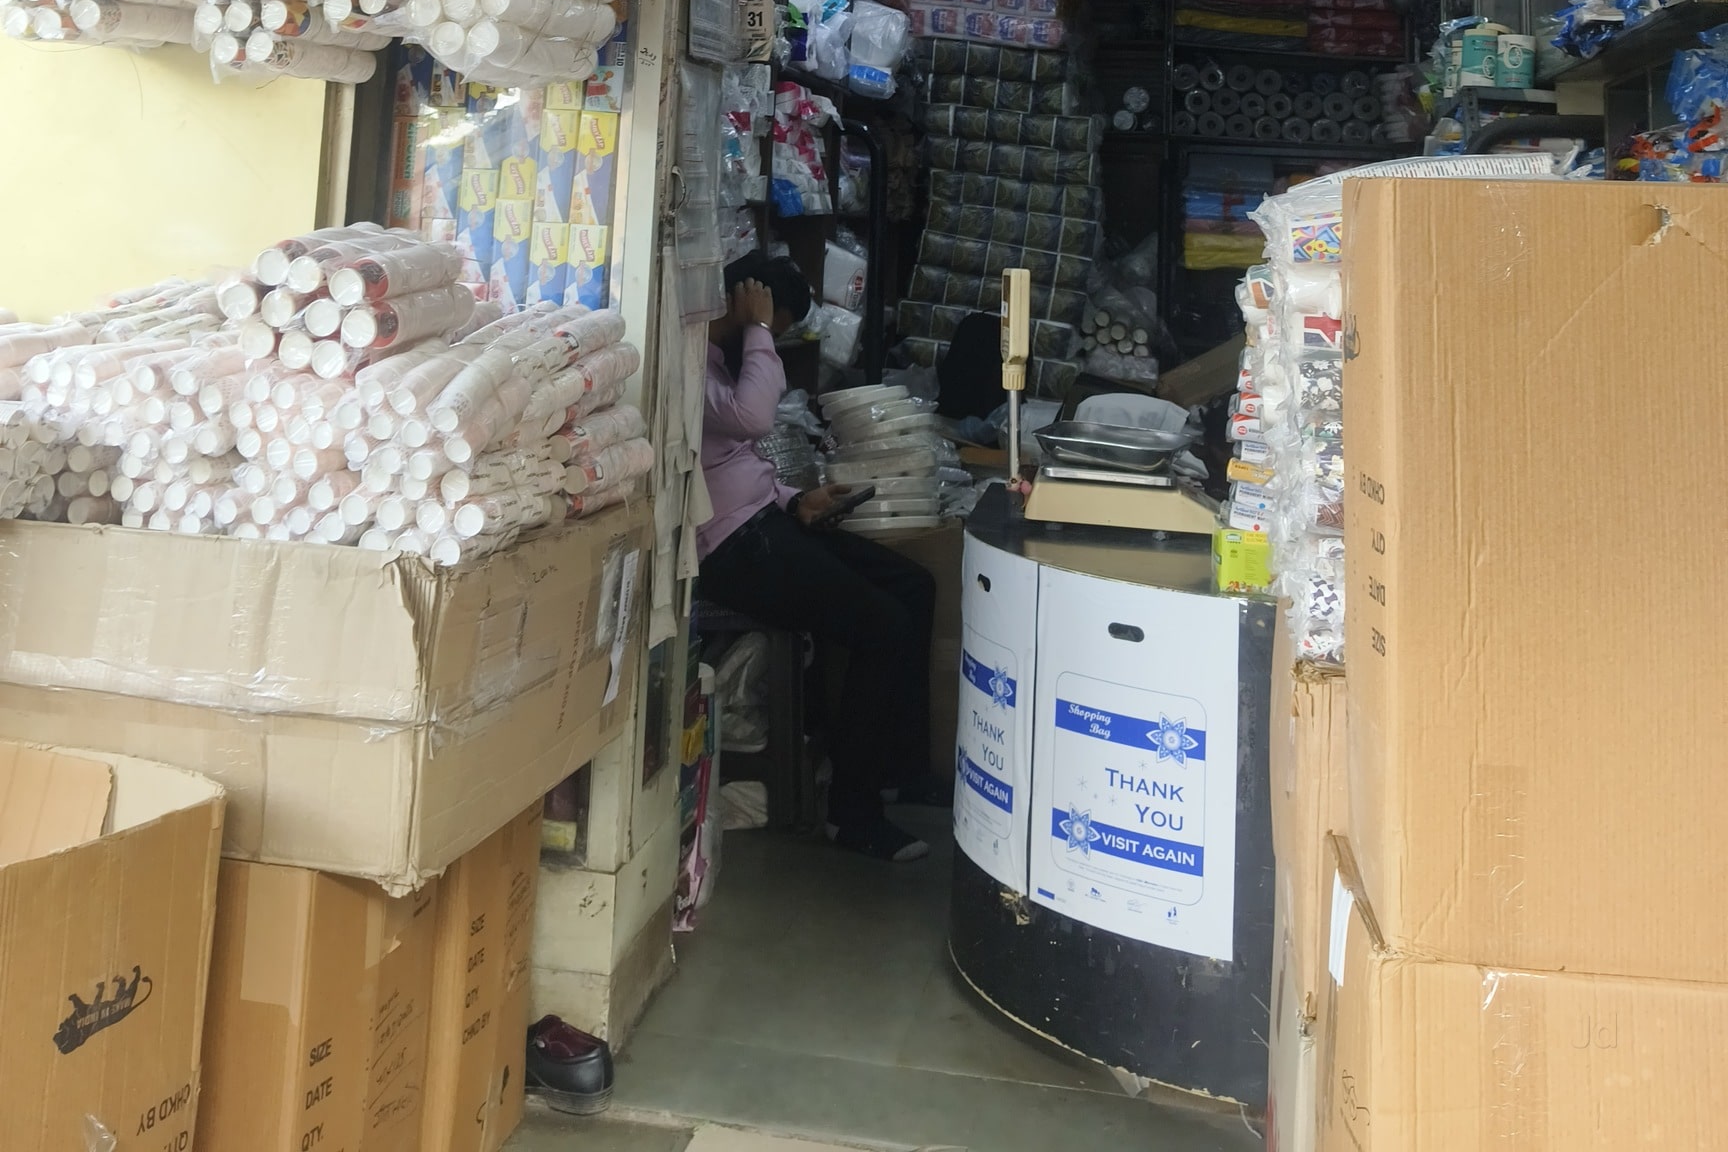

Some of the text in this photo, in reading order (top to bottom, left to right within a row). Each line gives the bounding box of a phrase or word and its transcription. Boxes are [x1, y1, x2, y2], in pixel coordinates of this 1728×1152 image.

[747, 11, 763, 27] 31
[1368, 575, 1386, 606] DATE
[1371, 626, 1386, 657] SIZE
[972, 709, 1005, 746] THANK
[1068, 703, 1112, 726] Shopping
[1089, 723, 1111, 740] Bag
[981, 743, 1005, 772] YOU
[983, 780, 1010, 805] AGAIN
[1104, 767, 1185, 804] THANK
[1135, 804, 1185, 833] YOU
[1100, 831, 1196, 868] VISIT AGAIN
[470, 913, 486, 937] SIZE
[467, 947, 486, 973] DATE
[479, 1009, 492, 1031] BY
[309, 1037, 333, 1068] SIZE
[305, 1076, 333, 1111] DATE
[136, 1084, 191, 1136] CHKD BY
